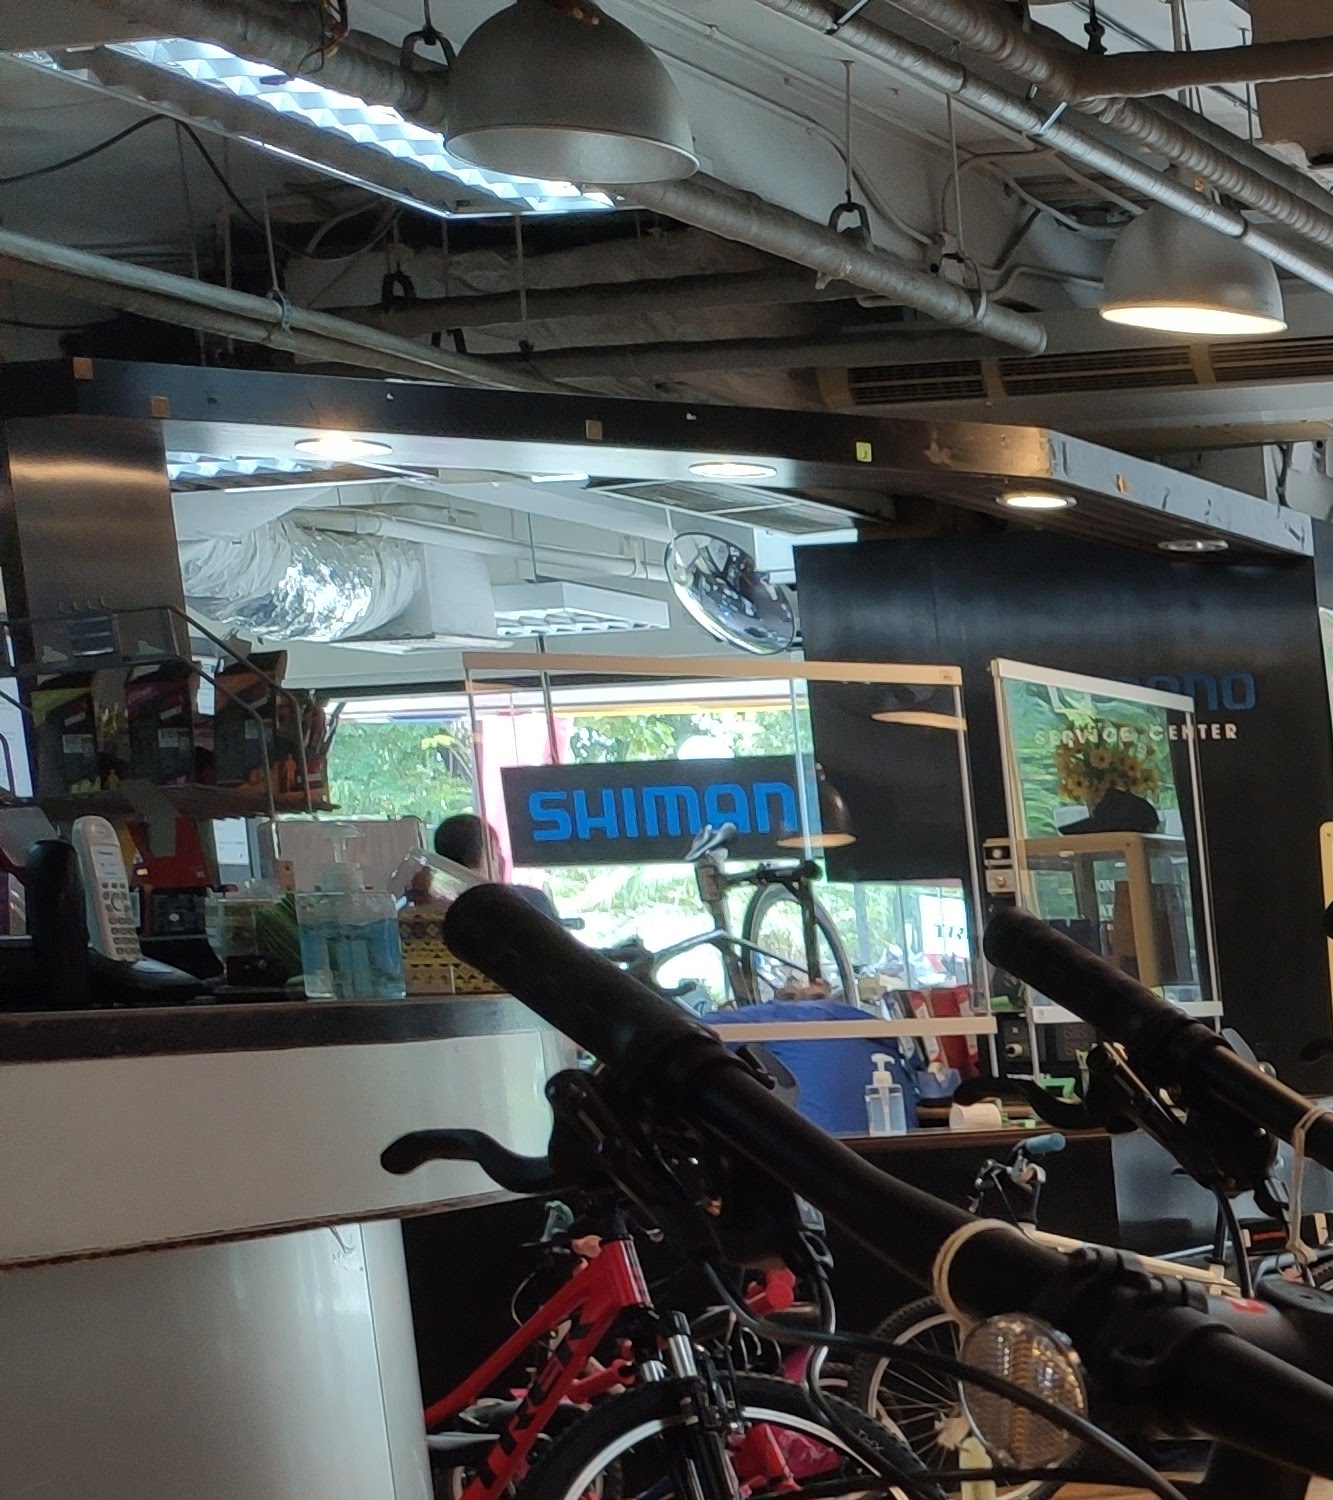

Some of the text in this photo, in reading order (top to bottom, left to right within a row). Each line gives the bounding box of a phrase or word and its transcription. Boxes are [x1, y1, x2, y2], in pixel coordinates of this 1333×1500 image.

[1149, 722, 1238, 741] CENTER
[527, 780, 800, 843] SHIMAN
[479, 1306, 592, 1489] TREK
